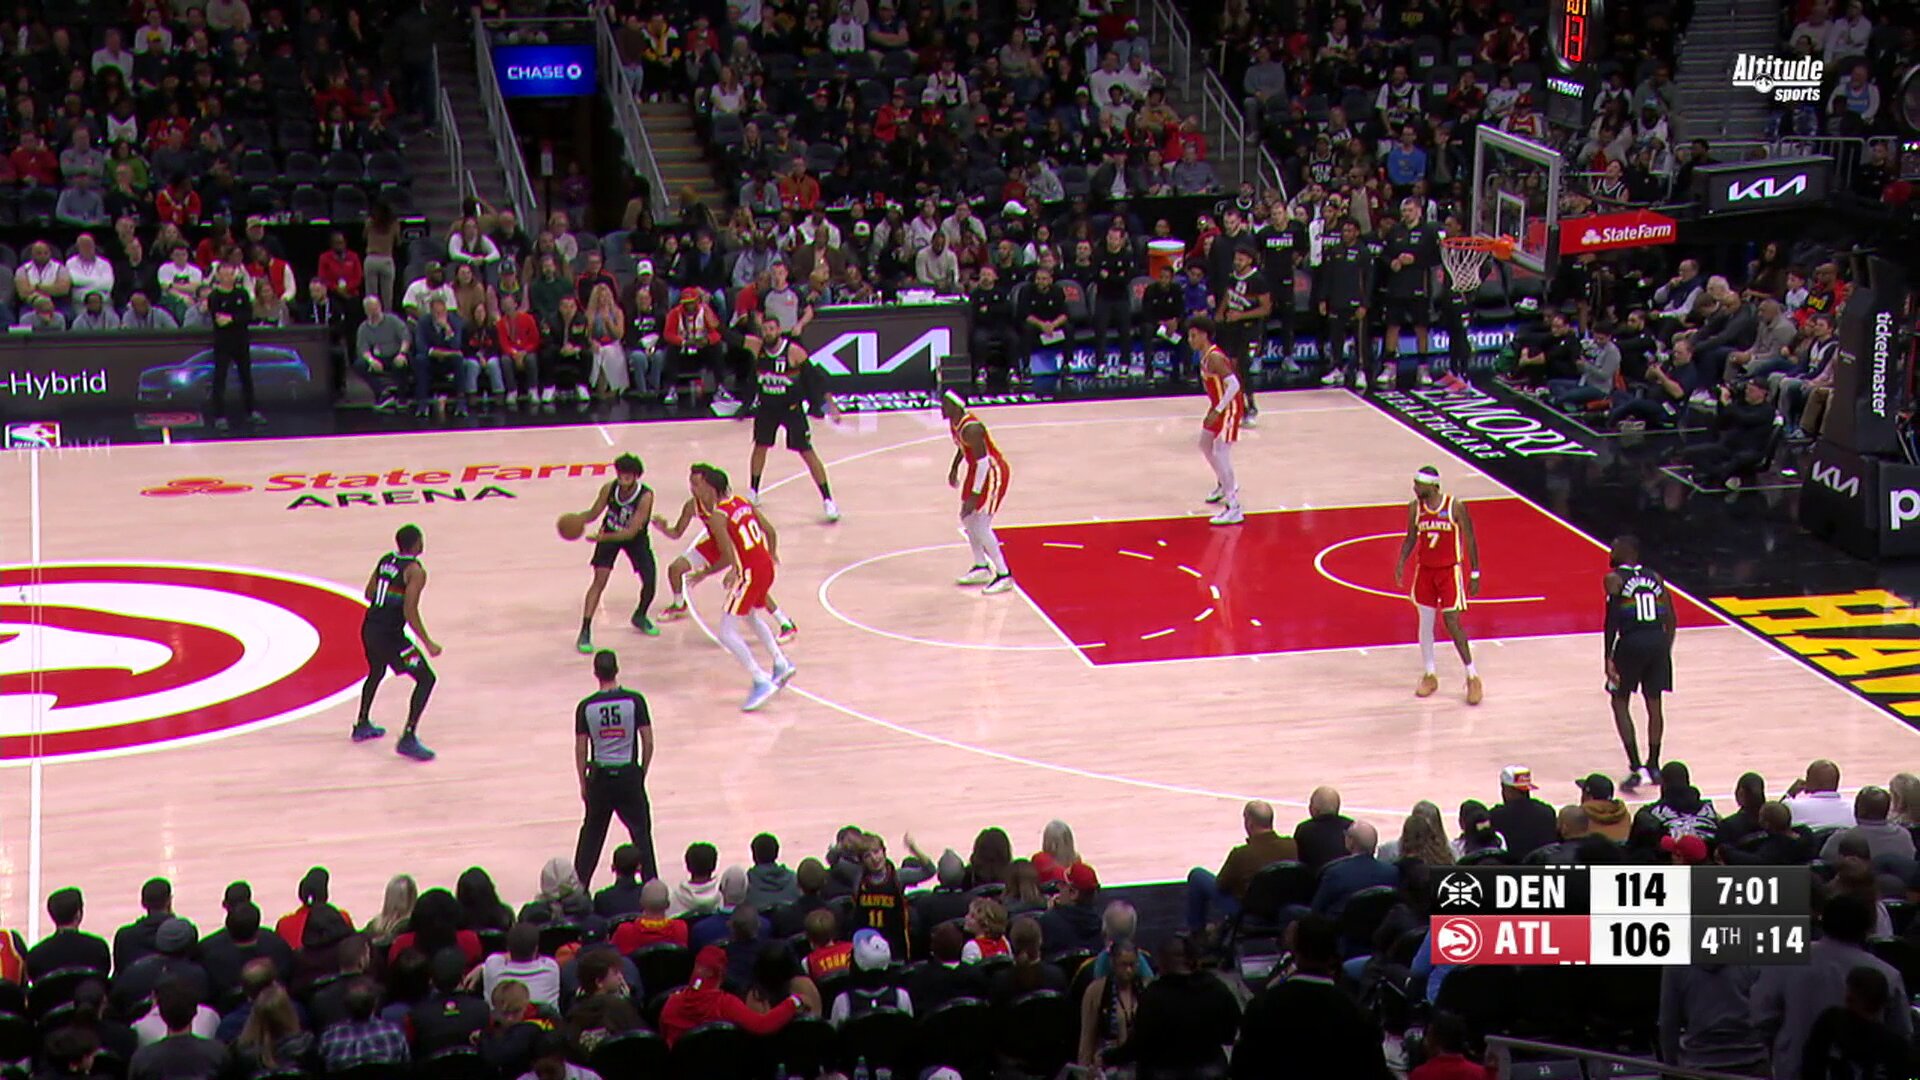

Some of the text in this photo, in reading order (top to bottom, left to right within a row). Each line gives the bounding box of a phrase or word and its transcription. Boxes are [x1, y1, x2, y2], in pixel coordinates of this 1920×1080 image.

[507, 66, 565, 80] CHASE
[1872, 312, 1893, 418] ticketmaster
[1409, 389, 1599, 457] EMORY
[286, 485, 518, 510] ARENA
[739, 518, 762, 551] 10
[1427, 532, 1440, 549] 7
[375, 578, 389, 608] 11
[1635, 592, 1657, 621] 10
[599, 705, 621, 727] 35
[869, 909, 884, 928] 11
